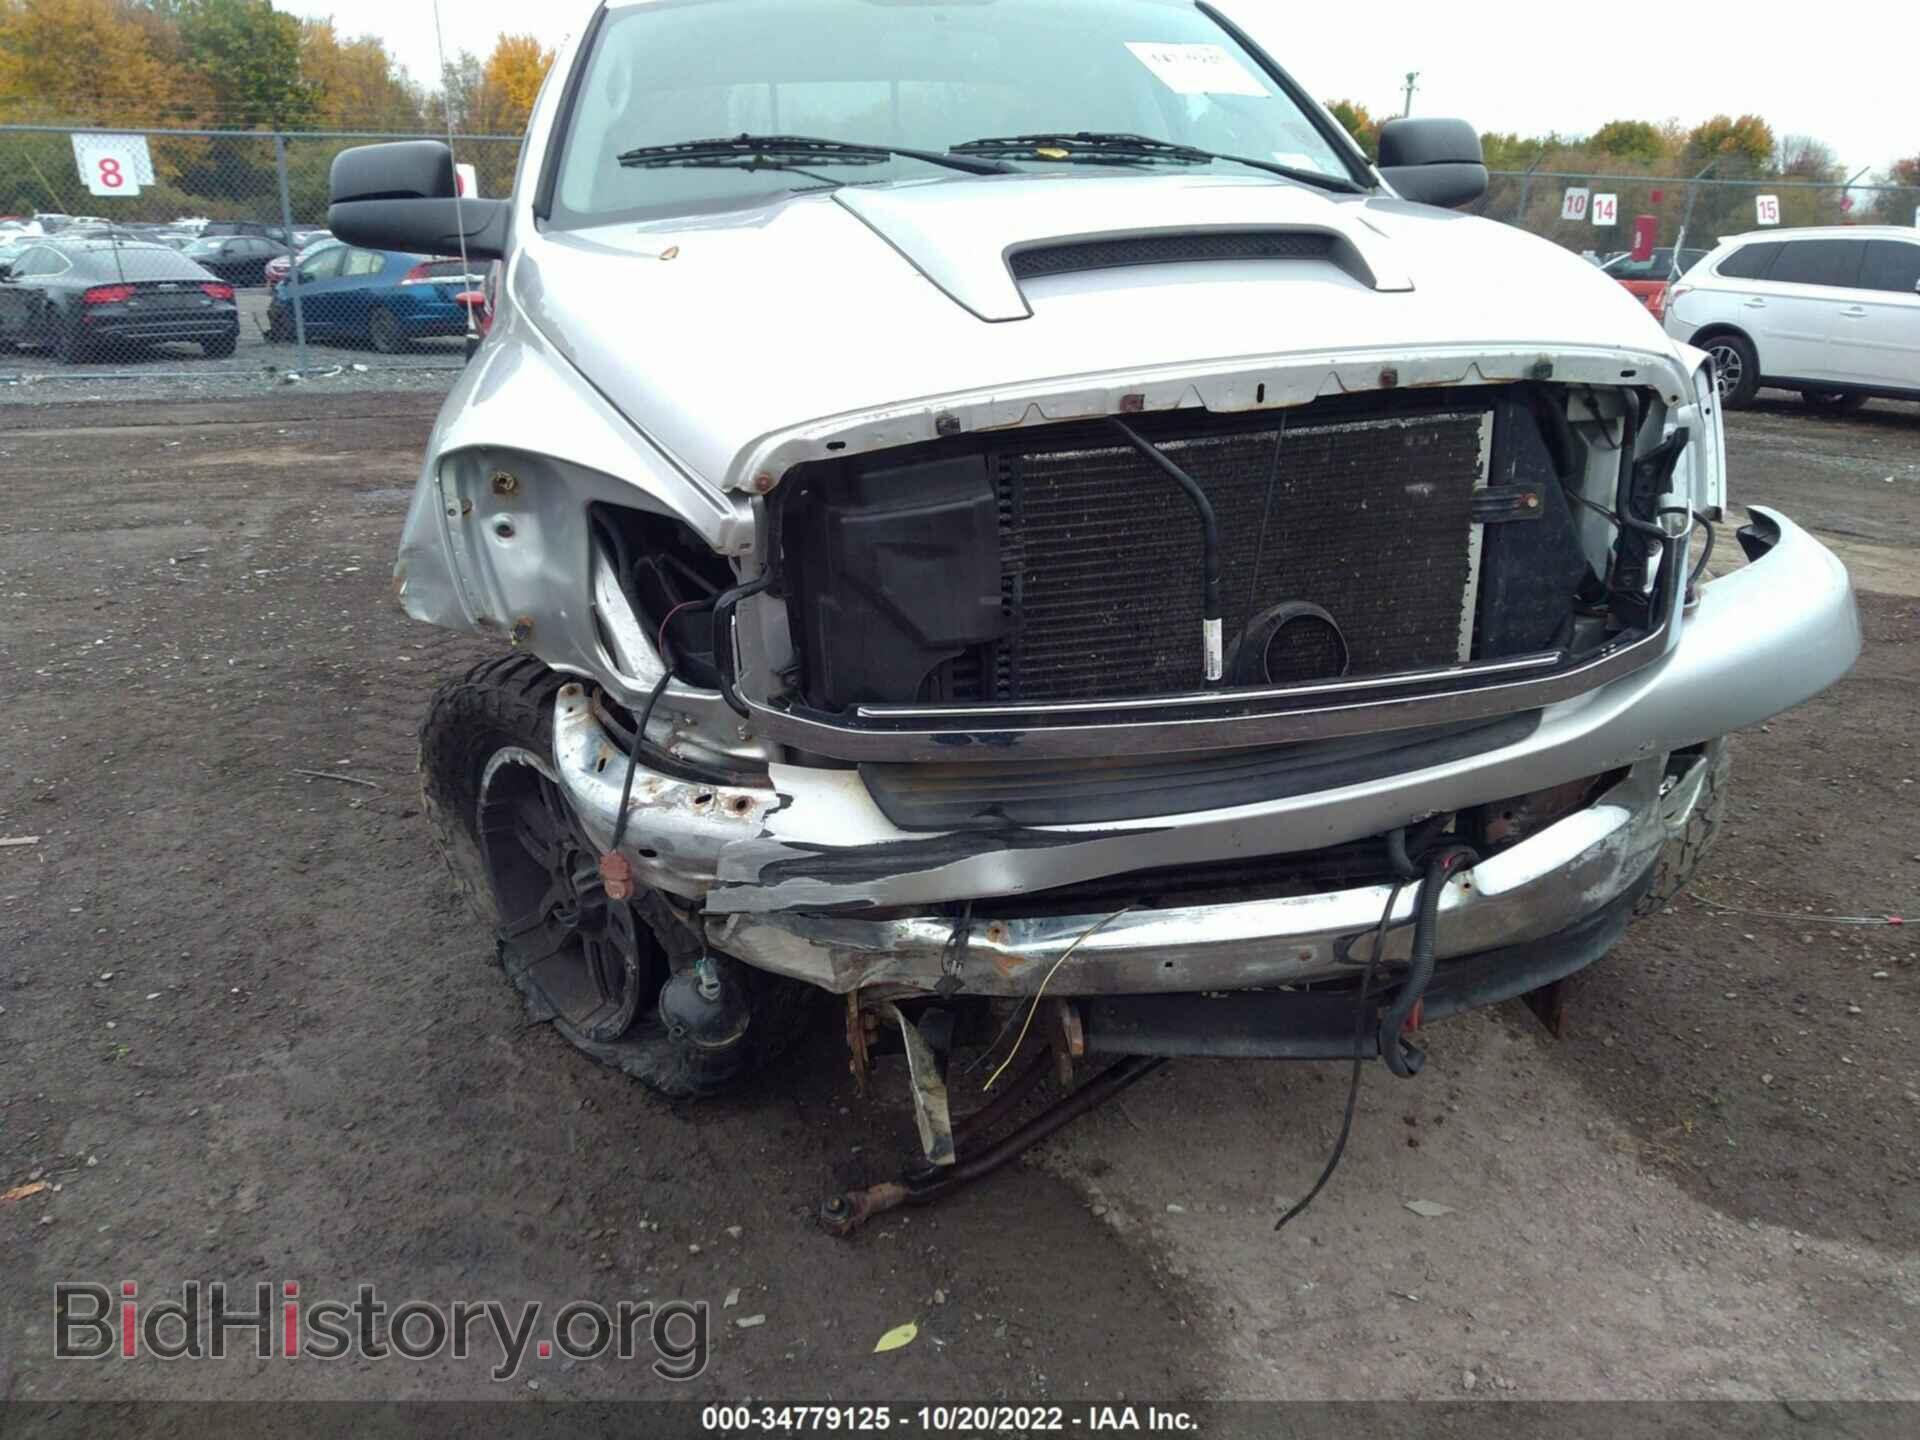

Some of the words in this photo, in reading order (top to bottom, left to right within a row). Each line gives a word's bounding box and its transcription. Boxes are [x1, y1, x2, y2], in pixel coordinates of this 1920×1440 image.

[98, 158, 124, 188] 8
[1567, 195, 1585, 214] 10
[1595, 199, 1614, 220] 14
[1759, 200, 1777, 220] 15
